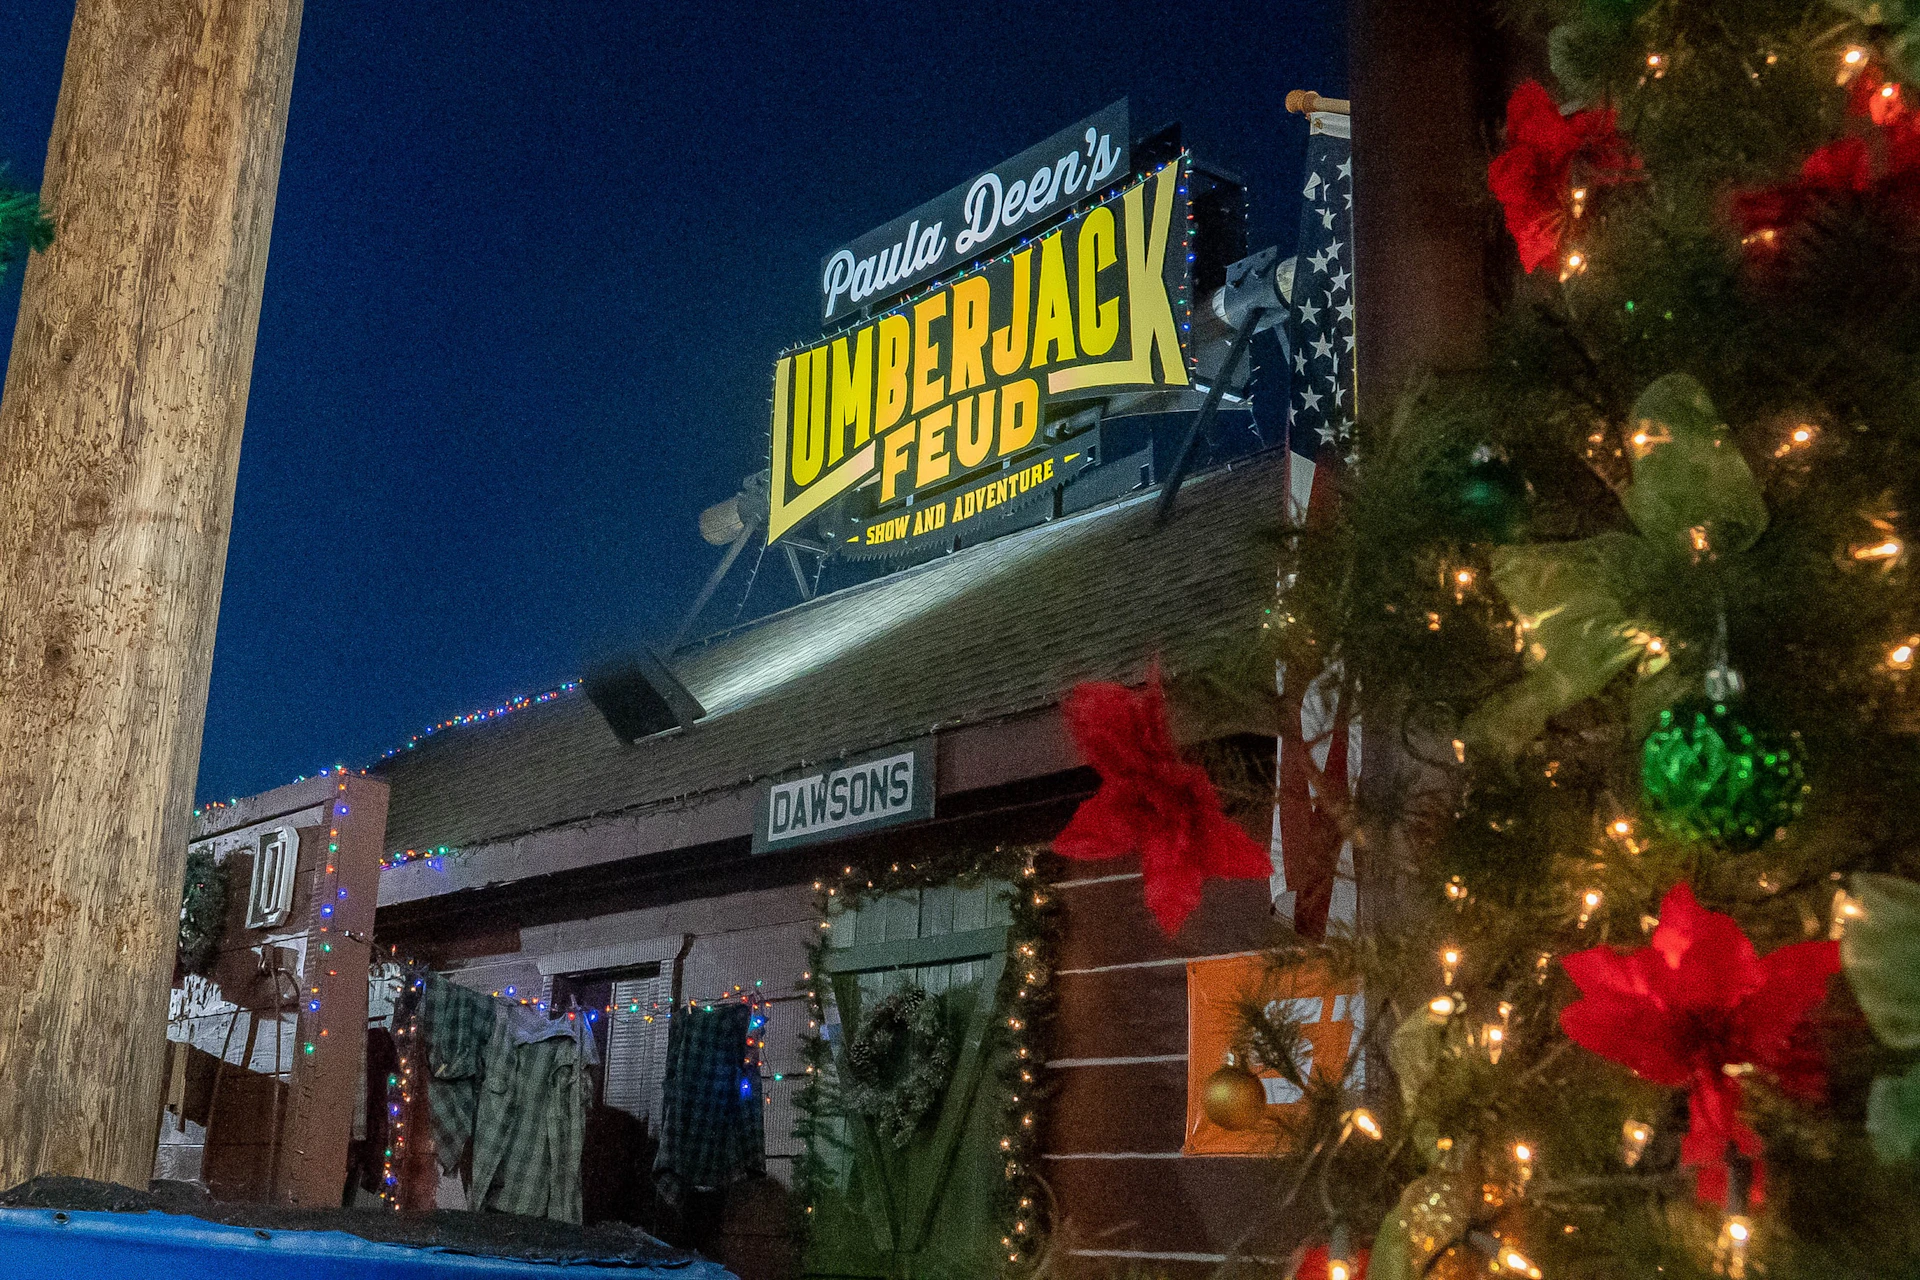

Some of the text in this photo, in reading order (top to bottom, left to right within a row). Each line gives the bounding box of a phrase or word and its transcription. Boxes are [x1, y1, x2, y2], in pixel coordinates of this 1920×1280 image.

[823, 127, 1121, 318] Paula Deen's
[768, 158, 1189, 545] LUMBERJACK
[866, 458, 1054, 545] SHOW AND ADVENTURE
[879, 378, 1039, 503] FEUD
[772, 761, 910, 835] DAWSONS
